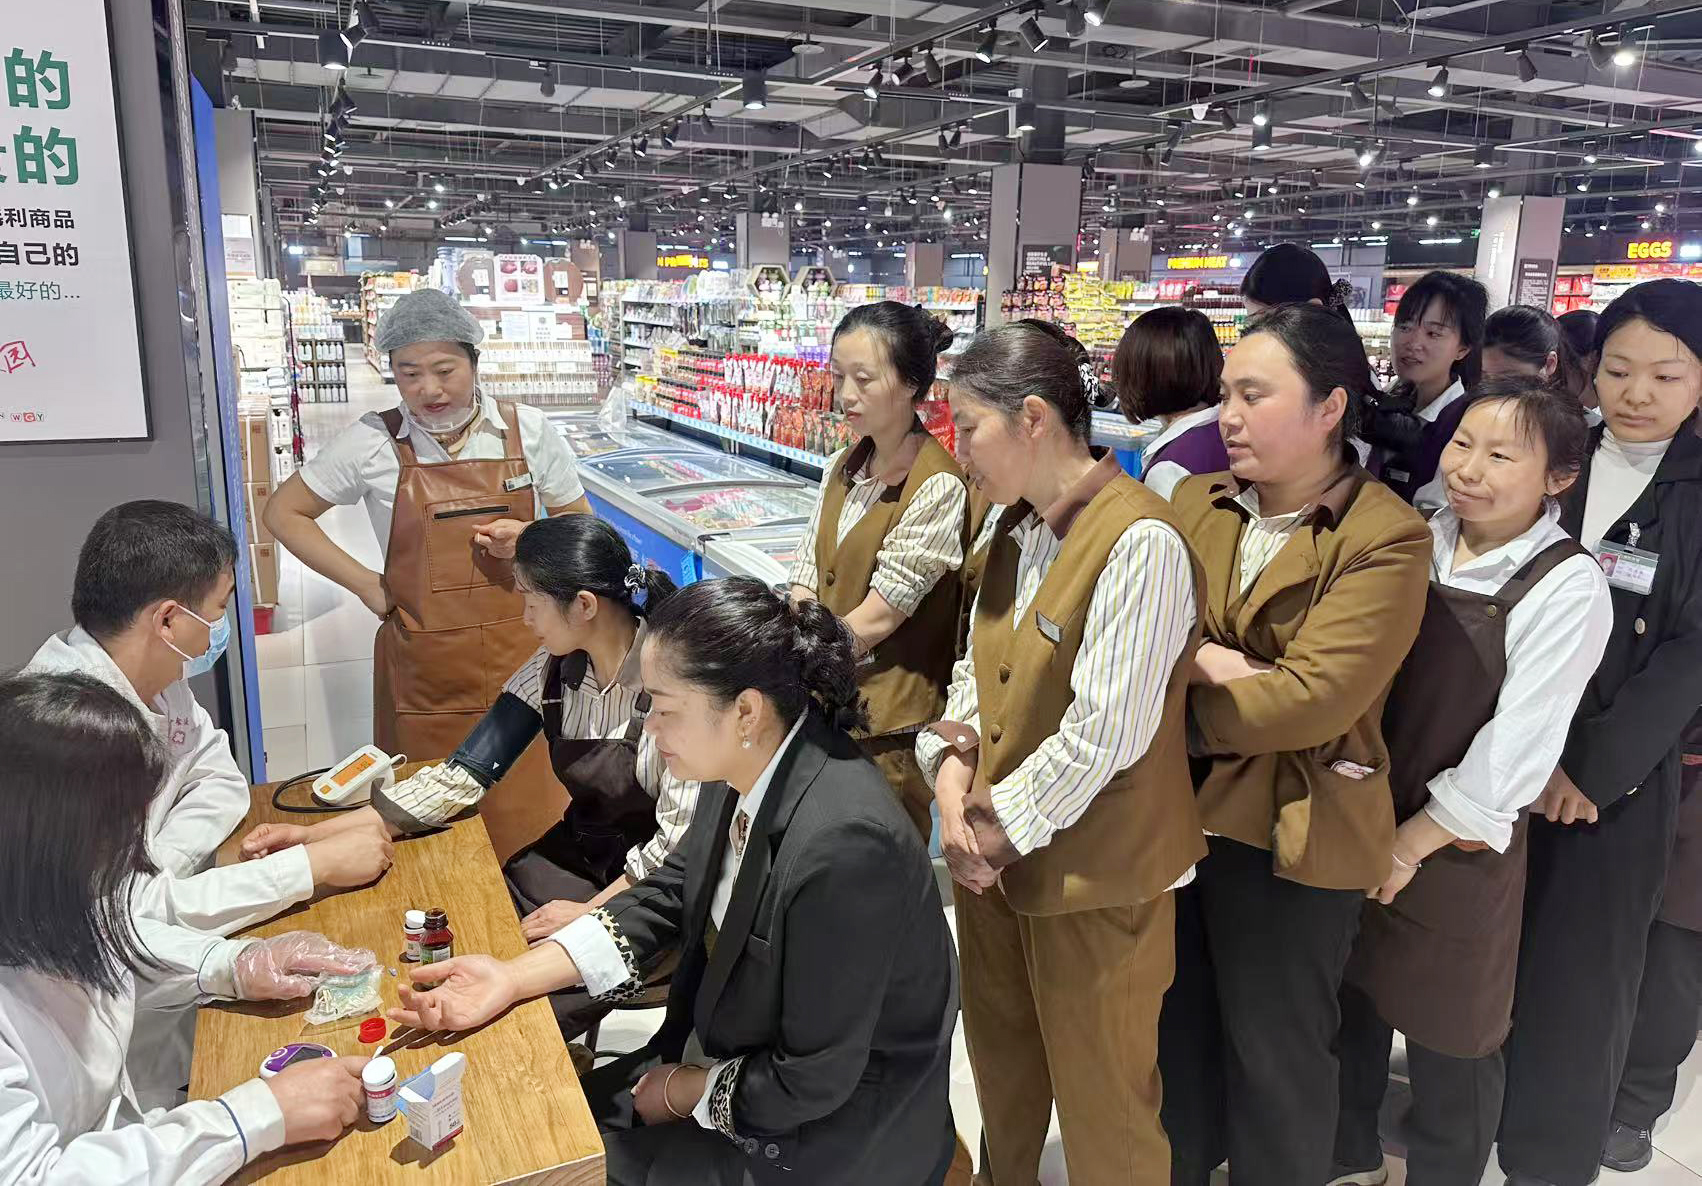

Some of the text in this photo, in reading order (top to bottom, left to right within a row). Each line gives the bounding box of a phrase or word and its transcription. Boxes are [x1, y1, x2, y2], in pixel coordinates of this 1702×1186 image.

[4, 47, 71, 109] 的
[0, 125, 78, 185] 的
[0, 207, 75, 230] 利商品
[0, 241, 79, 267] 自己的
[1627, 241, 1673, 259] EGGS
